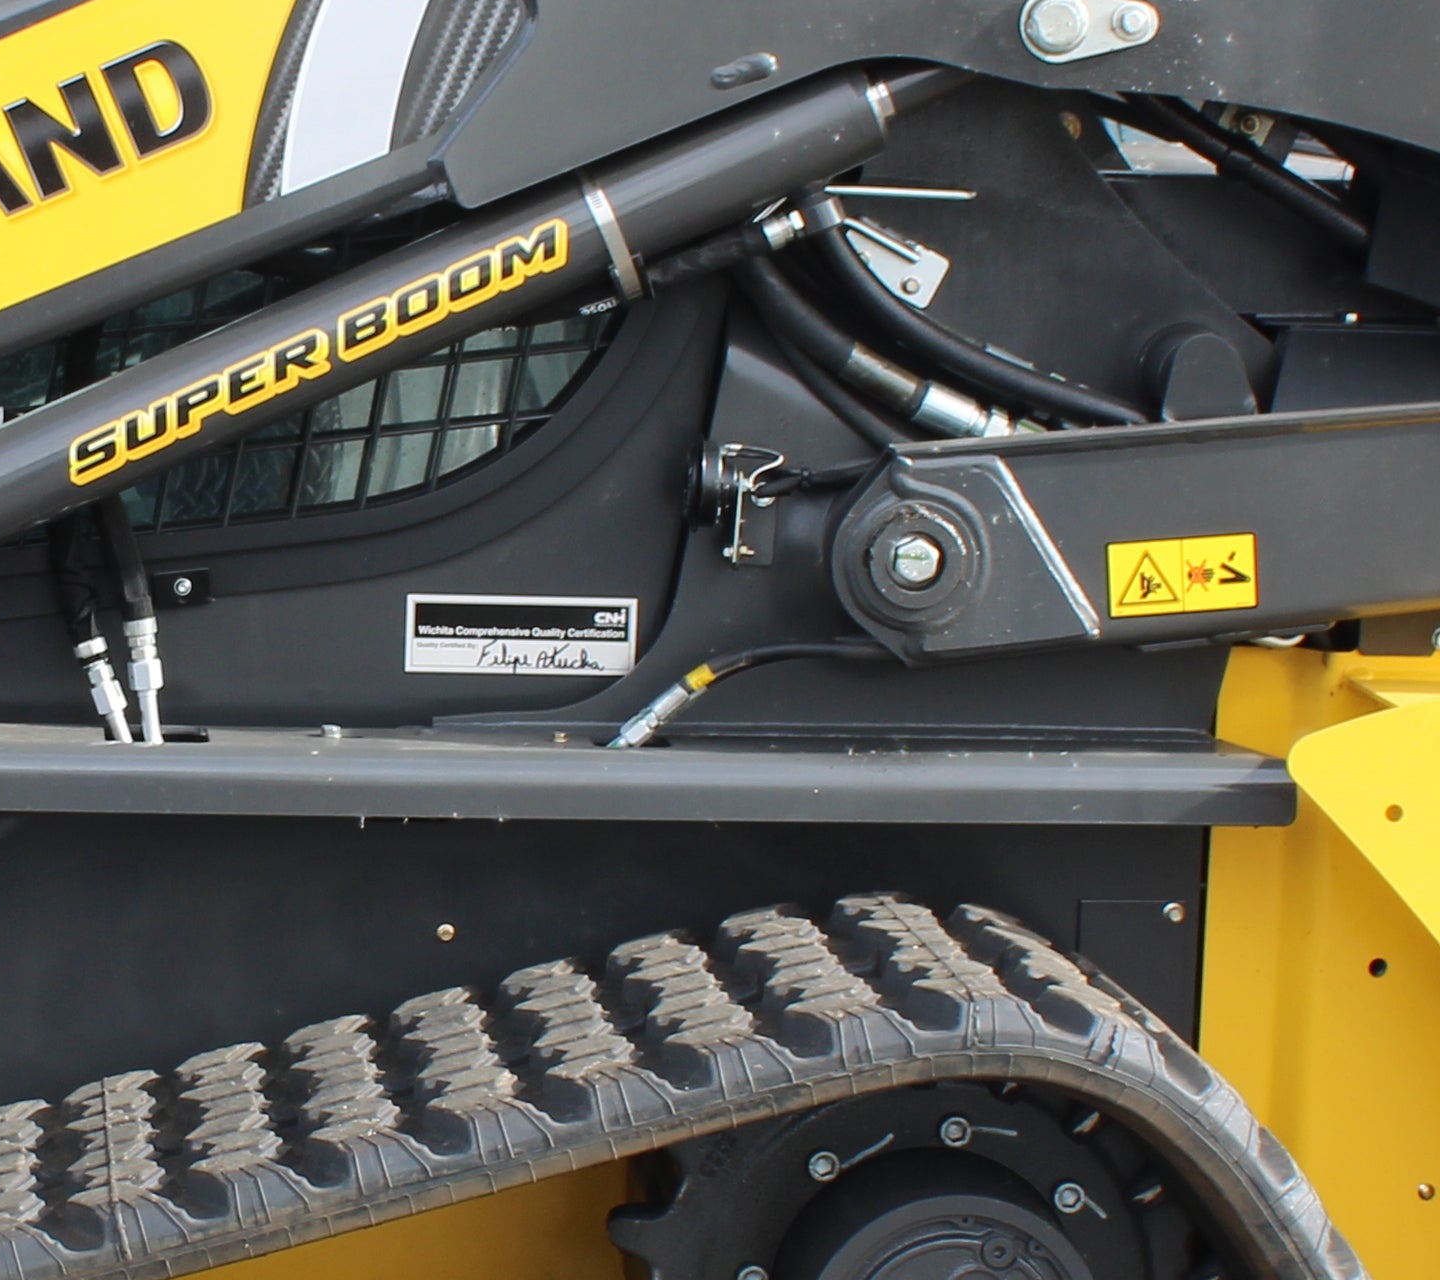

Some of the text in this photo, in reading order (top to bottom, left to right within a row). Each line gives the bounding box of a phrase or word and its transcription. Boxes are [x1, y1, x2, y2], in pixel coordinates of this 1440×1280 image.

[69, 218, 570, 486] SUPER BOOM
[418, 625, 626, 640] Wichita Comprehensive Quality Certification
